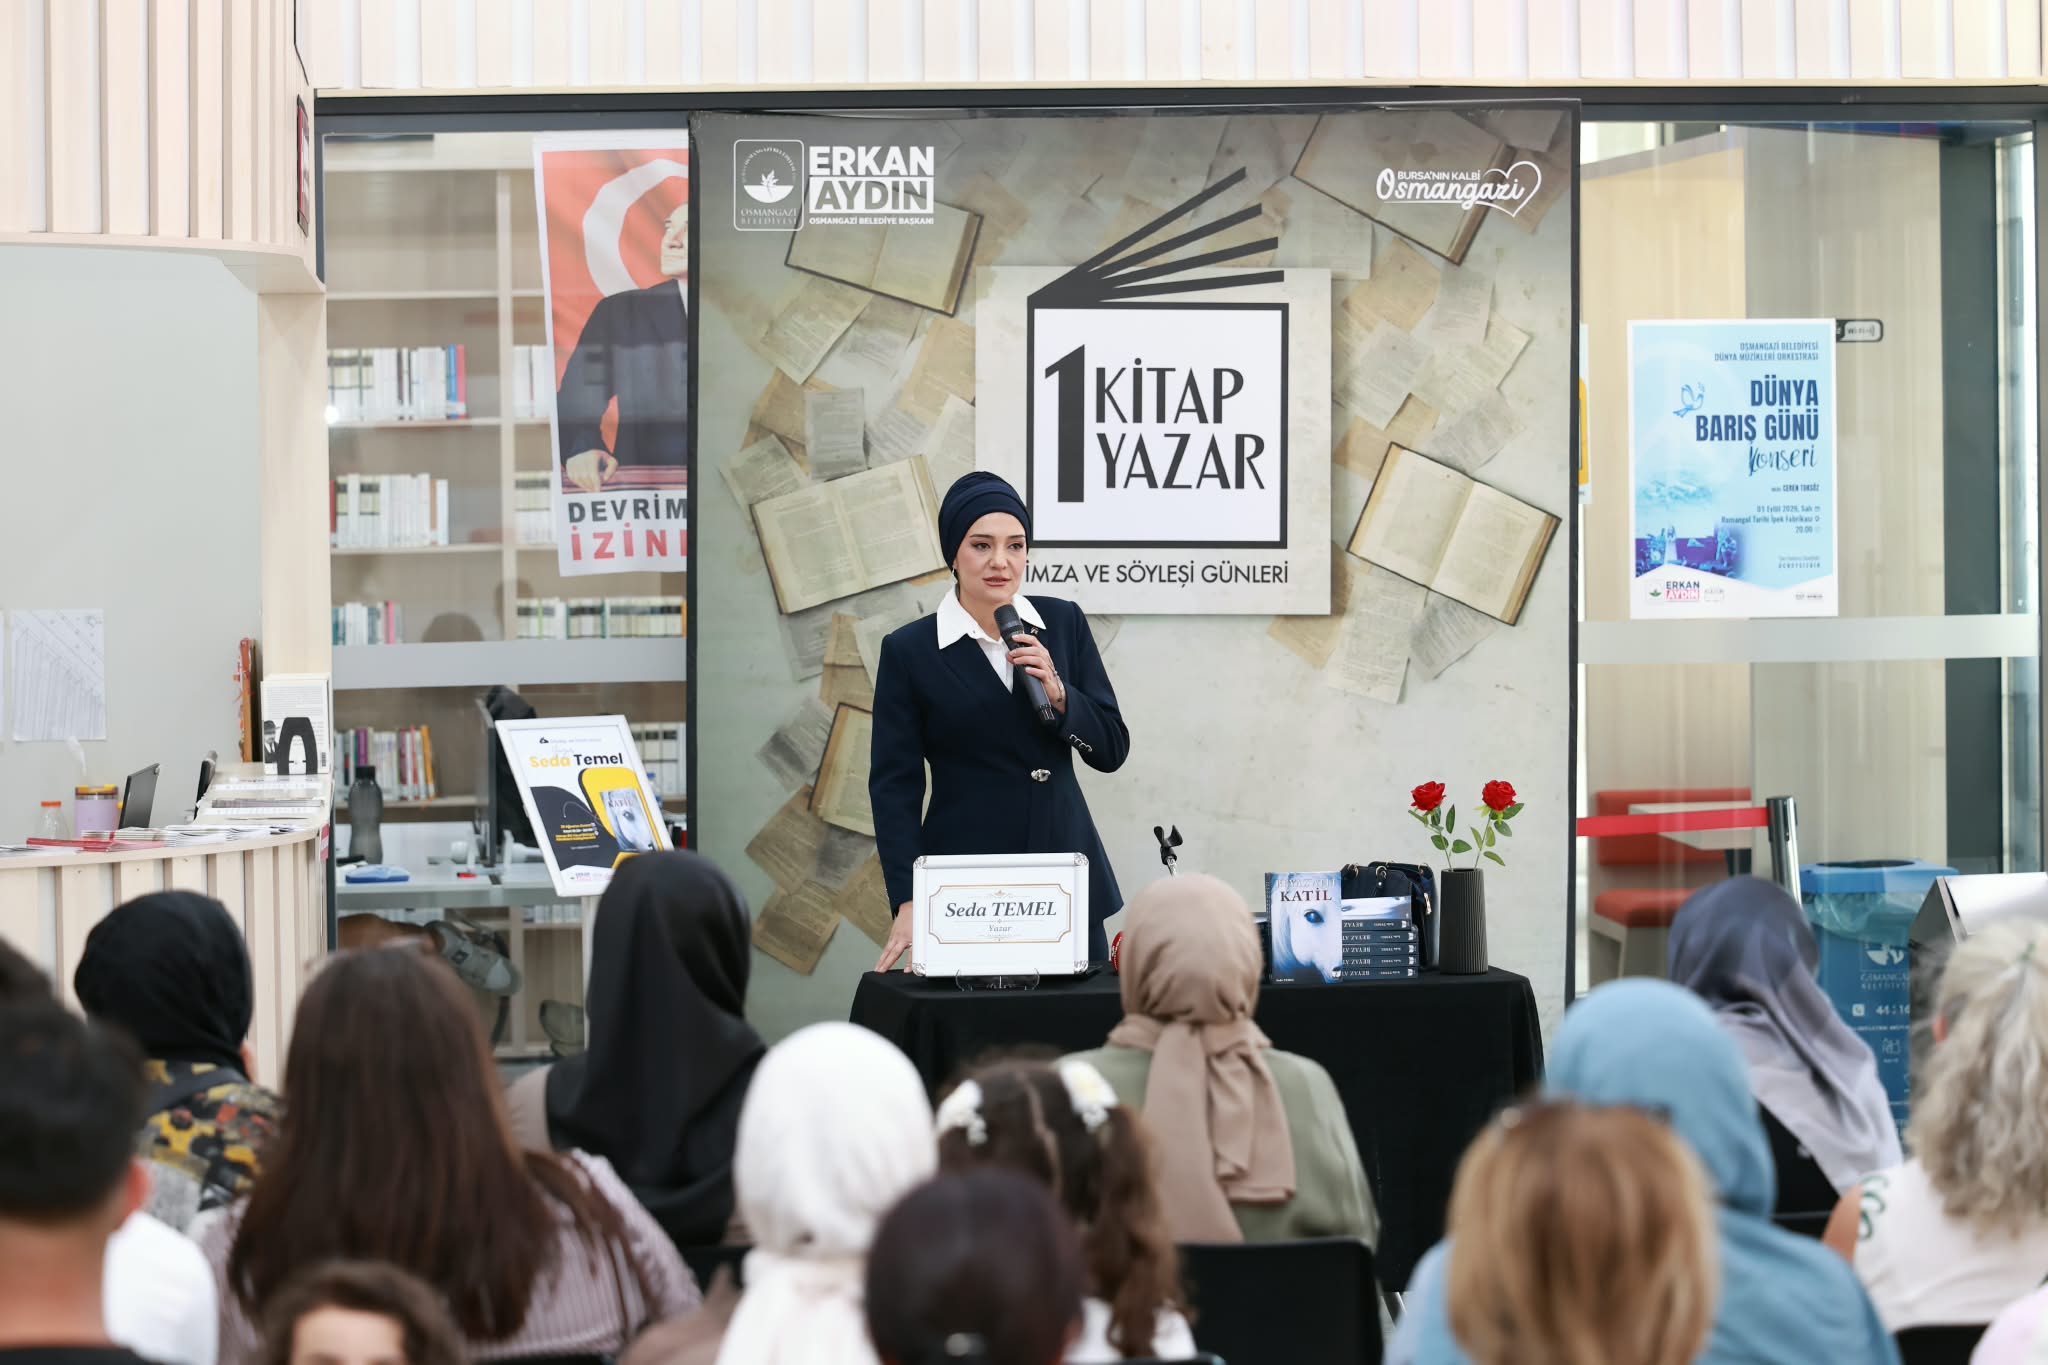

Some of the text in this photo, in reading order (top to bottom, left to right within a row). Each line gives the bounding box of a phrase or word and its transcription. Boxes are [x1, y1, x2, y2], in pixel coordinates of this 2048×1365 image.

[809, 146, 935, 176] ERKAN
[1398, 169, 1481, 181] BURSA'NIN KALBİ
[814, 180, 928, 210] AYDIN
[1376, 167, 1526, 211] Osmangazi
[809, 216, 935, 227] OSMANGAZİ BELEDİYE BAŞKANI
[1750, 374, 1819, 407] DÜNYA
[1045, 344, 1244, 503] 1 KİTAP
[1696, 409, 1819, 445] BARIŞ GÜNÜ
[1096, 432, 1265, 489] YAZAR
[1748, 444, 1817, 476] Konseri
[568, 493, 688, 523] DEVRİM
[1025, 561, 1288, 588] İMZA VE SÖYLEŞİ GÜNLERİ
[1666, 581, 1700, 590] ERKAN
[1667, 591, 1700, 600] AYDIN
[529, 752, 623, 769] Seda Temel
[1280, 887, 1332, 902] KATİL
[945, 901, 1057, 917] Seda TEMEL
[989, 924, 1012, 932] Yazar
